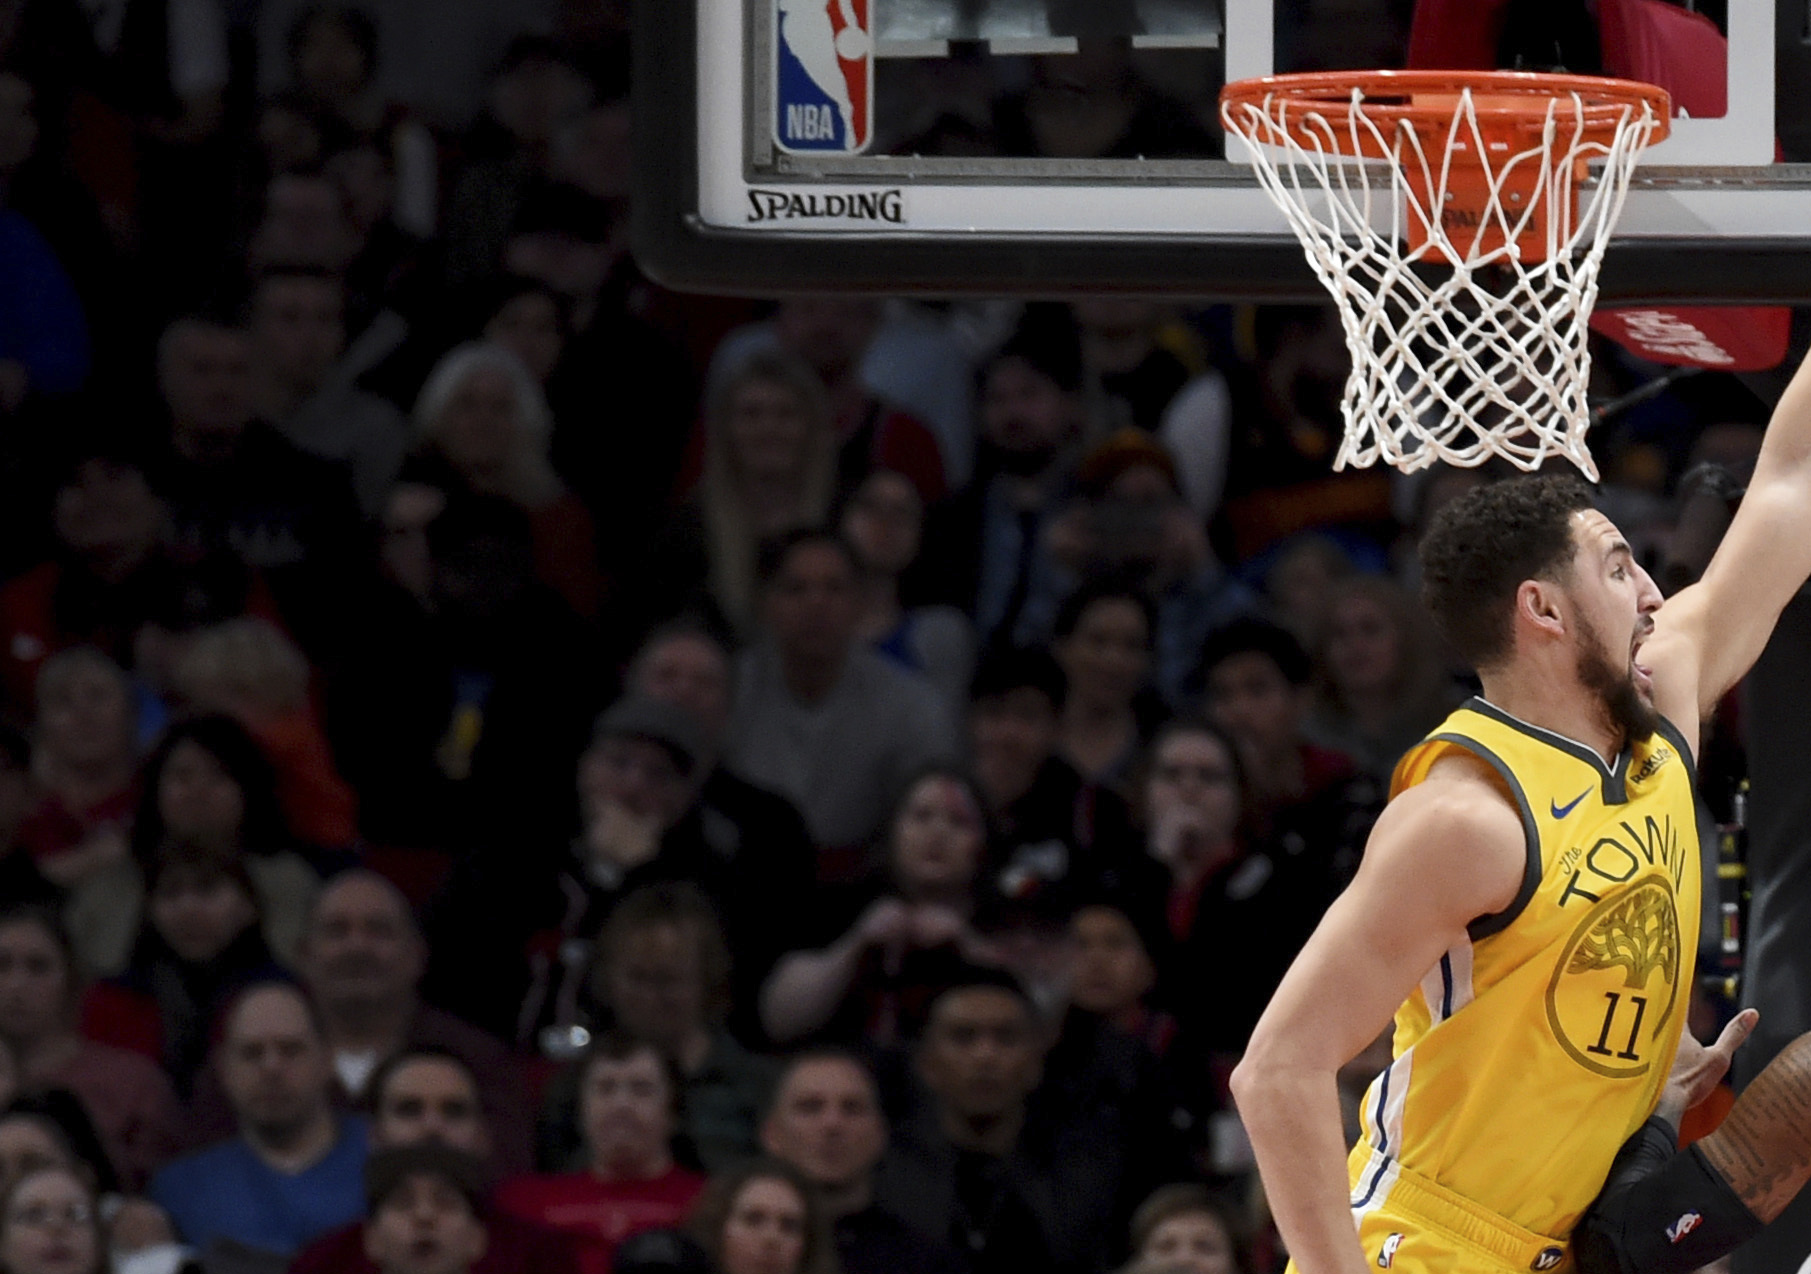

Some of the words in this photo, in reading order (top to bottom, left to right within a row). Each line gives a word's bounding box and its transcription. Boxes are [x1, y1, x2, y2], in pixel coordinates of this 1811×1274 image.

[787, 104, 835, 141] NBA
[748, 188, 903, 224] SPALDING
[1558, 847, 1582, 875] The
[1558, 814, 1686, 908] TOWN
[1587, 991, 1648, 1061] 11
